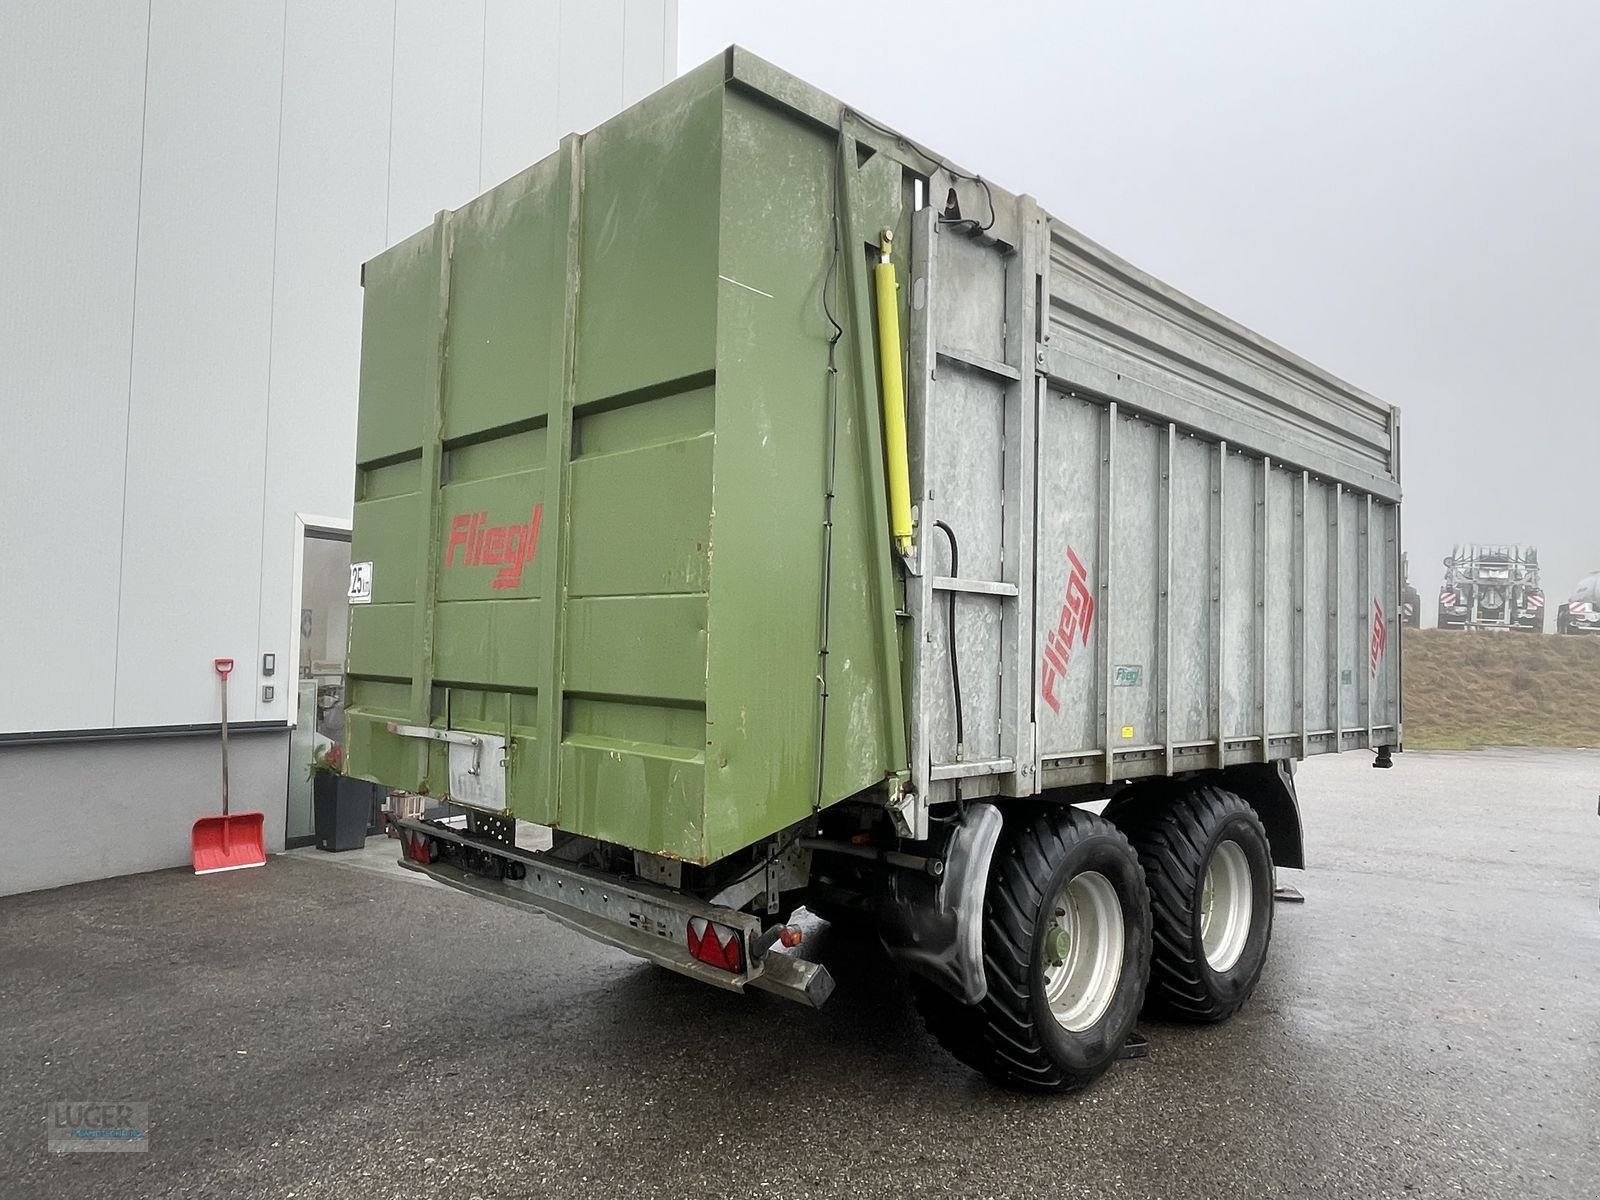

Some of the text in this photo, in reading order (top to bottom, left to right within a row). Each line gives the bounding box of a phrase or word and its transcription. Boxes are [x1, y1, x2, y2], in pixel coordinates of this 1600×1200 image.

[351, 567, 363, 594] 25
[445, 503, 543, 590] Fliegl
[1042, 545, 1095, 716] Fliegl
